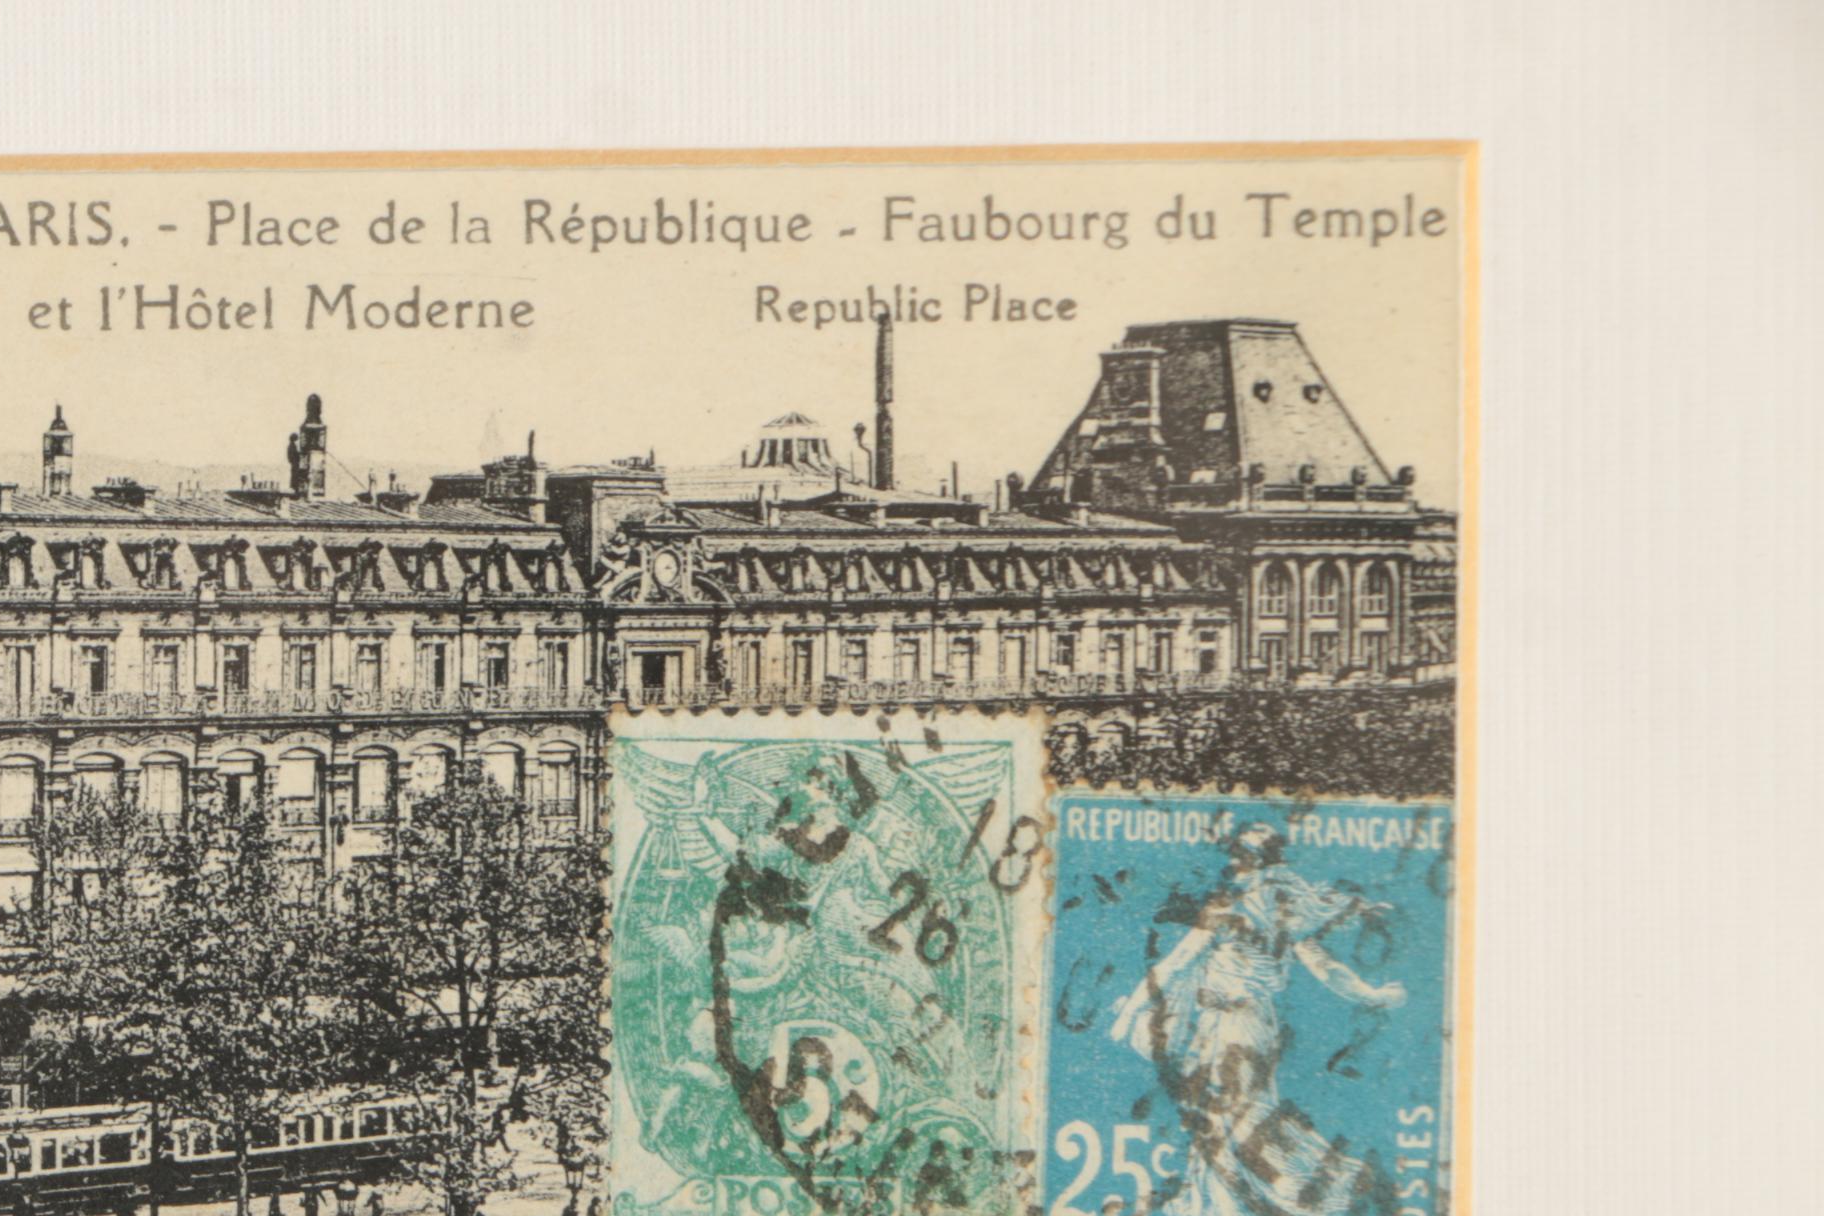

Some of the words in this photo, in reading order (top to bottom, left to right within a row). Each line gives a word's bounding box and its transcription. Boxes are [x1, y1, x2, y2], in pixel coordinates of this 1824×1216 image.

[206, 199, 340, 247] Place
[368, 199, 425, 245] de
[450, 201, 492, 244] la
[523, 197, 812, 254] République
[882, 194, 1129, 250] Faubourg
[1155, 194, 1217, 241] du
[1244, 192, 1447, 248] Temple
[28, 297, 73, 331] et
[99, 284, 273, 332] l'Hôtel
[304, 283, 535, 331] Moderne
[754, 284, 943, 331] Republic
[963, 282, 1078, 323] Place
